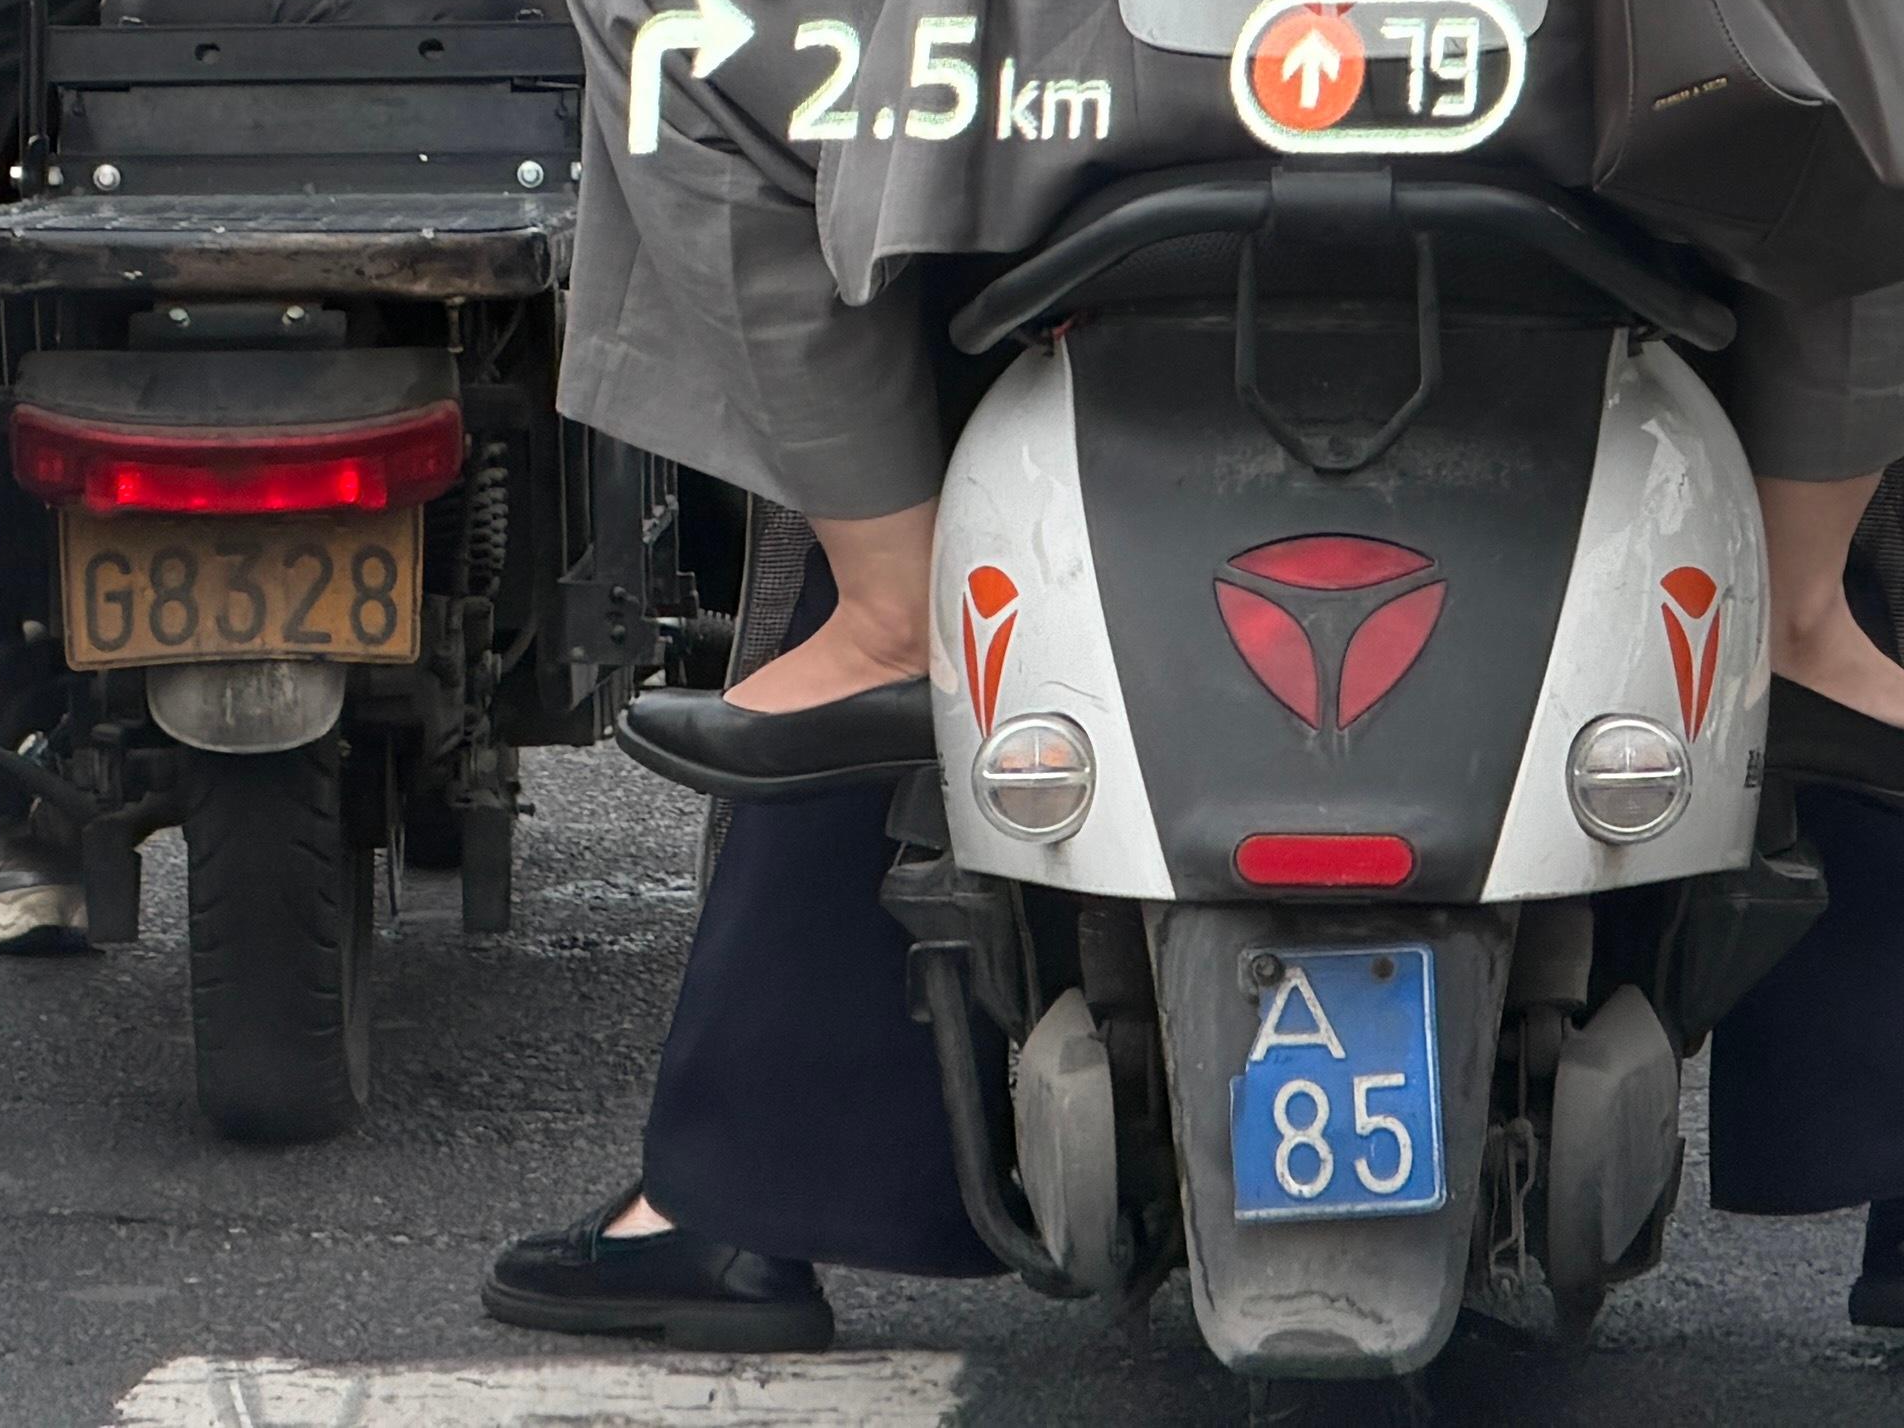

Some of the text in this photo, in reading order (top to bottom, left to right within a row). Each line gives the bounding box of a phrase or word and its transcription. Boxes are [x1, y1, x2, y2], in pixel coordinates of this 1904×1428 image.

[1380, 16, 1480, 118] 79
[1249, 966, 1346, 1062] A
[1273, 1072, 1415, 1200] 85
